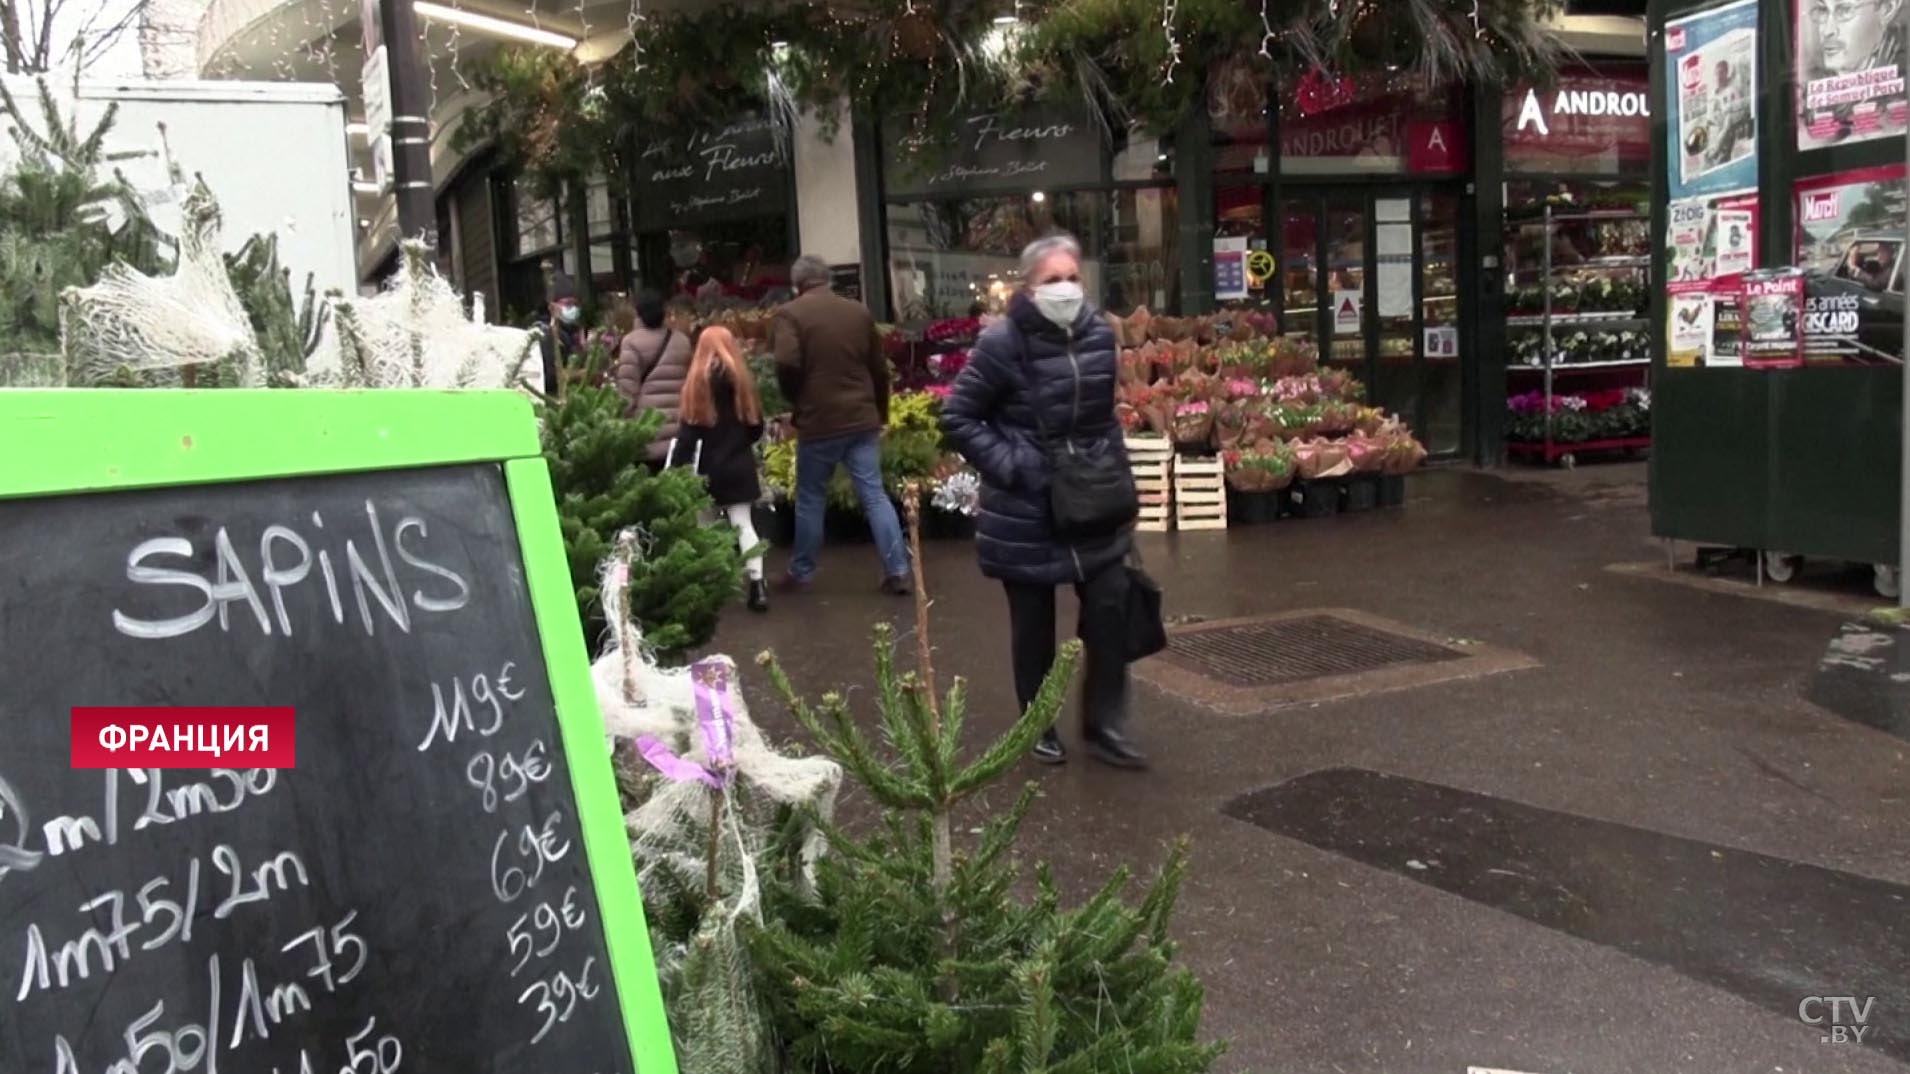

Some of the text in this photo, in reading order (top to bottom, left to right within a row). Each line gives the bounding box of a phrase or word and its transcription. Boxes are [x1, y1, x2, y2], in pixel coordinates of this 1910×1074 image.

[1427, 126, 1448, 153] A
[1517, 88, 1548, 135] A
[700, 144, 776, 182] Fleurs
[1746, 279, 1798, 295] Le Point
[467, 739, 552, 813] 89€
[491, 811, 571, 902] 69€
[506, 885, 586, 978] 59€
[517, 956, 600, 1045] 39€
